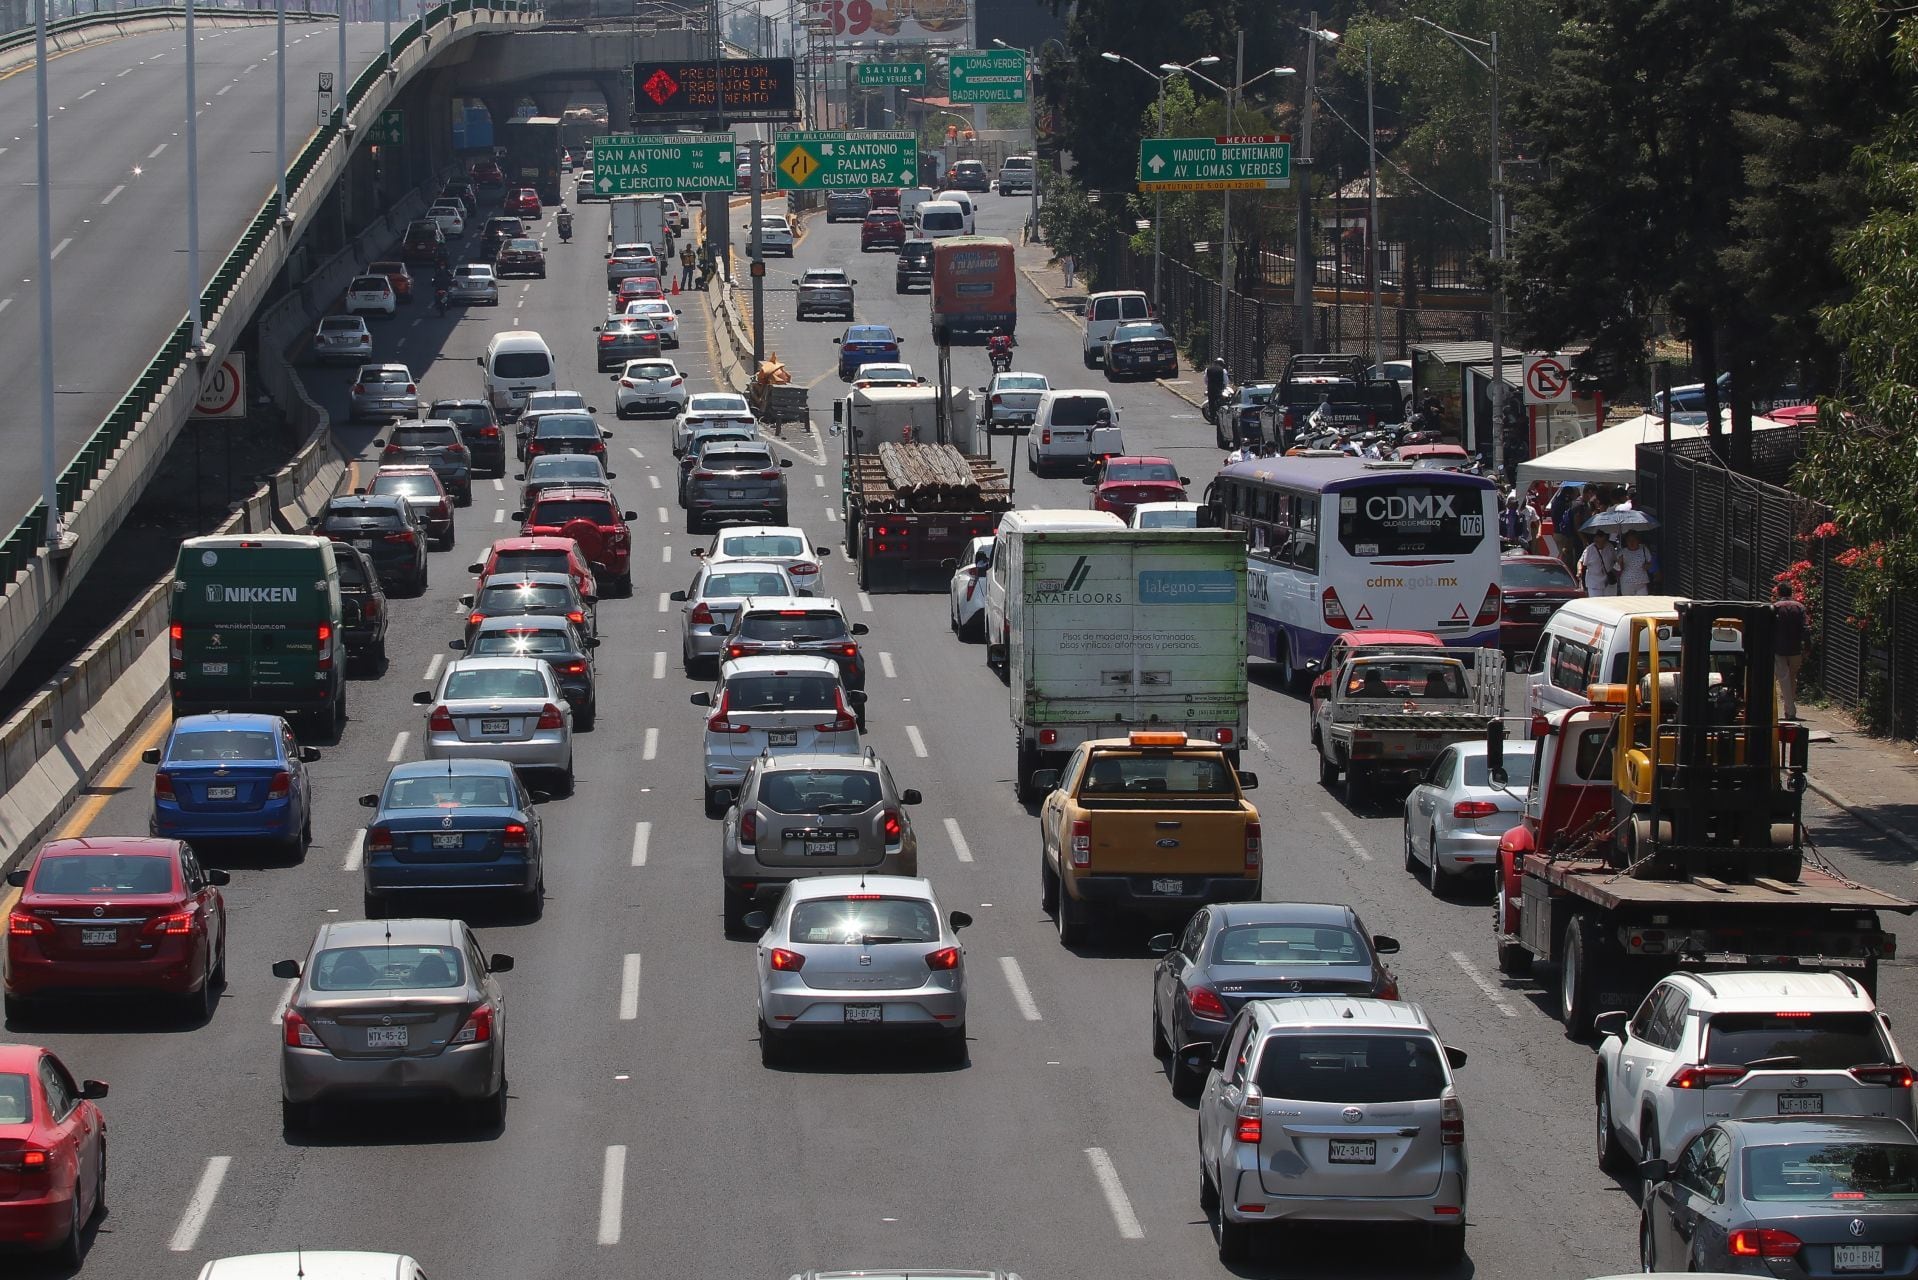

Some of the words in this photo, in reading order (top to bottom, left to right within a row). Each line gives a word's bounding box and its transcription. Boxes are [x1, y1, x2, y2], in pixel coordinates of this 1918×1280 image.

[966, 58, 992, 69] LOMAS
[993, 58, 1022, 69] VERDES
[865, 66, 907, 74] SALIDA
[321, 79, 330, 88] 57
[759, 79, 777, 91] EN
[861, 76, 884, 84] LOMAS
[886, 75, 912, 83] VERDES
[689, 93, 769, 104] PAVMENTO
[952, 89, 979, 100] BADEN
[979, 88, 1011, 100] POWELL
[321, 109, 328, 118] 5
[819, 131, 845, 140] CAMACHO
[1226, 136, 1264, 144] MEXICO
[597, 149, 624, 162] SAN
[628, 148, 681, 161] ANTONIO
[692, 150, 703, 158] TAG
[838, 144, 848, 156] S.
[849, 143, 898, 155] ANTONIO
[1173, 149, 1216, 161] VIADUCTO
[1222, 147, 1284, 160] BICENTENARIO
[597, 163, 648, 176] PALMAS
[837, 158, 887, 170] PALMAS
[1174, 165, 1189, 178] AV.
[1196, 164, 1233, 177] LOMAS
[1240, 162, 1282, 175] VERDES
[620, 177, 673, 189] EJERCITO
[677, 176, 733, 188] NACIONAL
[822, 173, 868, 185] GUSTAVO
[871, 172, 894, 184] BAZ
[1365, 495, 1457, 520] CDMX
[1462, 516, 1481, 534] 076
[1144, 579, 1196, 596] lalegno
[1248, 570, 1269, 603] CDMX
[1366, 576, 1458, 590] cdmx.gob.mx
[224, 587, 297, 602] NIKKEN
[1025, 593, 1123, 604] ZAYATFLOORS
[1062, 632, 1081, 641] Pisos
[1083, 632, 1094, 641] de
[1132, 633, 1152, 643] pisos
[1060, 641, 1080, 650] pisos
[1114, 641, 1154, 650] alfombras
[369, 1031, 407, 1041] NTX-45-23
[1780, 1099, 1821, 1110] NJF-18-16
[1330, 1145, 1374, 1156] NVZ-34-10
[1836, 1250, 1880, 1263] N90-BHZ
